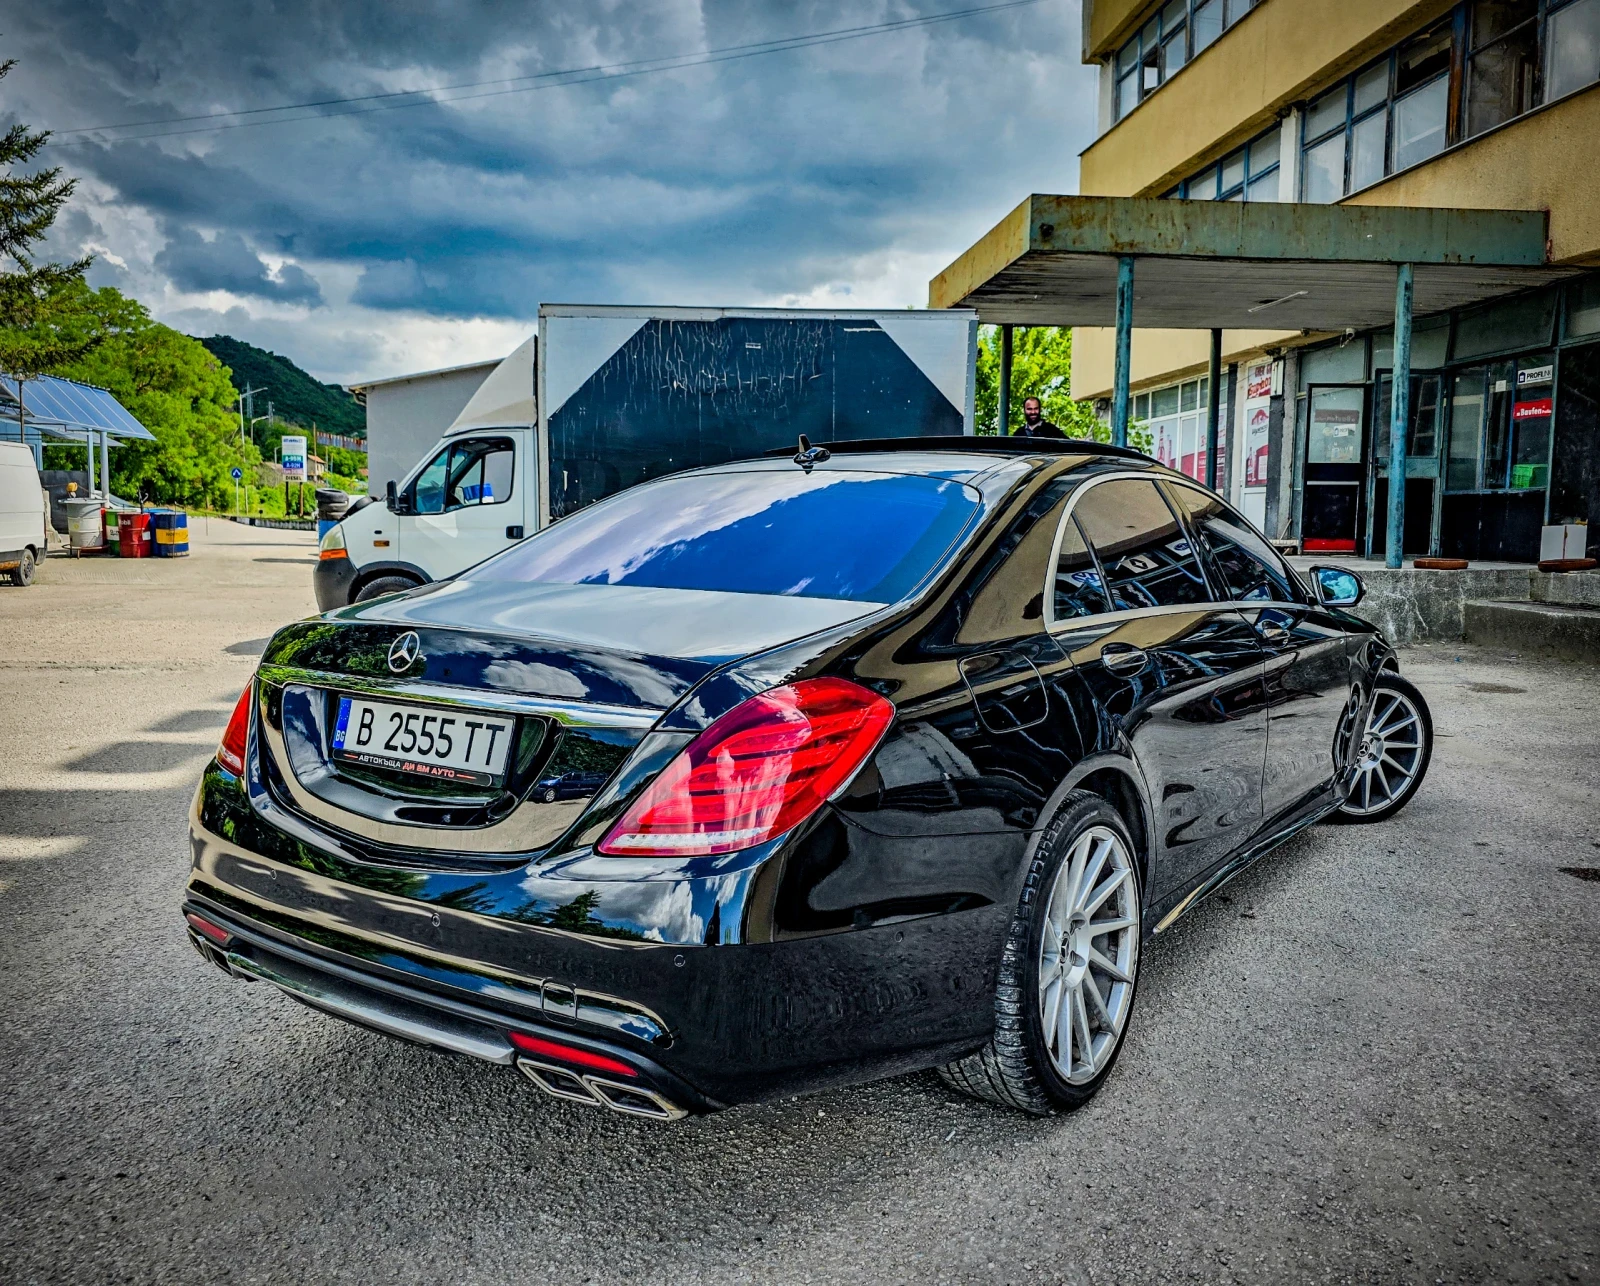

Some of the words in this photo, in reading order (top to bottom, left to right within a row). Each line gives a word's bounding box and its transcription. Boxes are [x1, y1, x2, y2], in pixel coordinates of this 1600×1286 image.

[336, 730, 346, 742] BG
[356, 708, 374, 746] B
[384, 712, 456, 758] 2555
[464, 722, 505, 766] TT
[359, 754, 400, 768] АВТОКЪЩА
[402, 762, 415, 770] ДИ
[431, 767, 454, 778] АУТО
